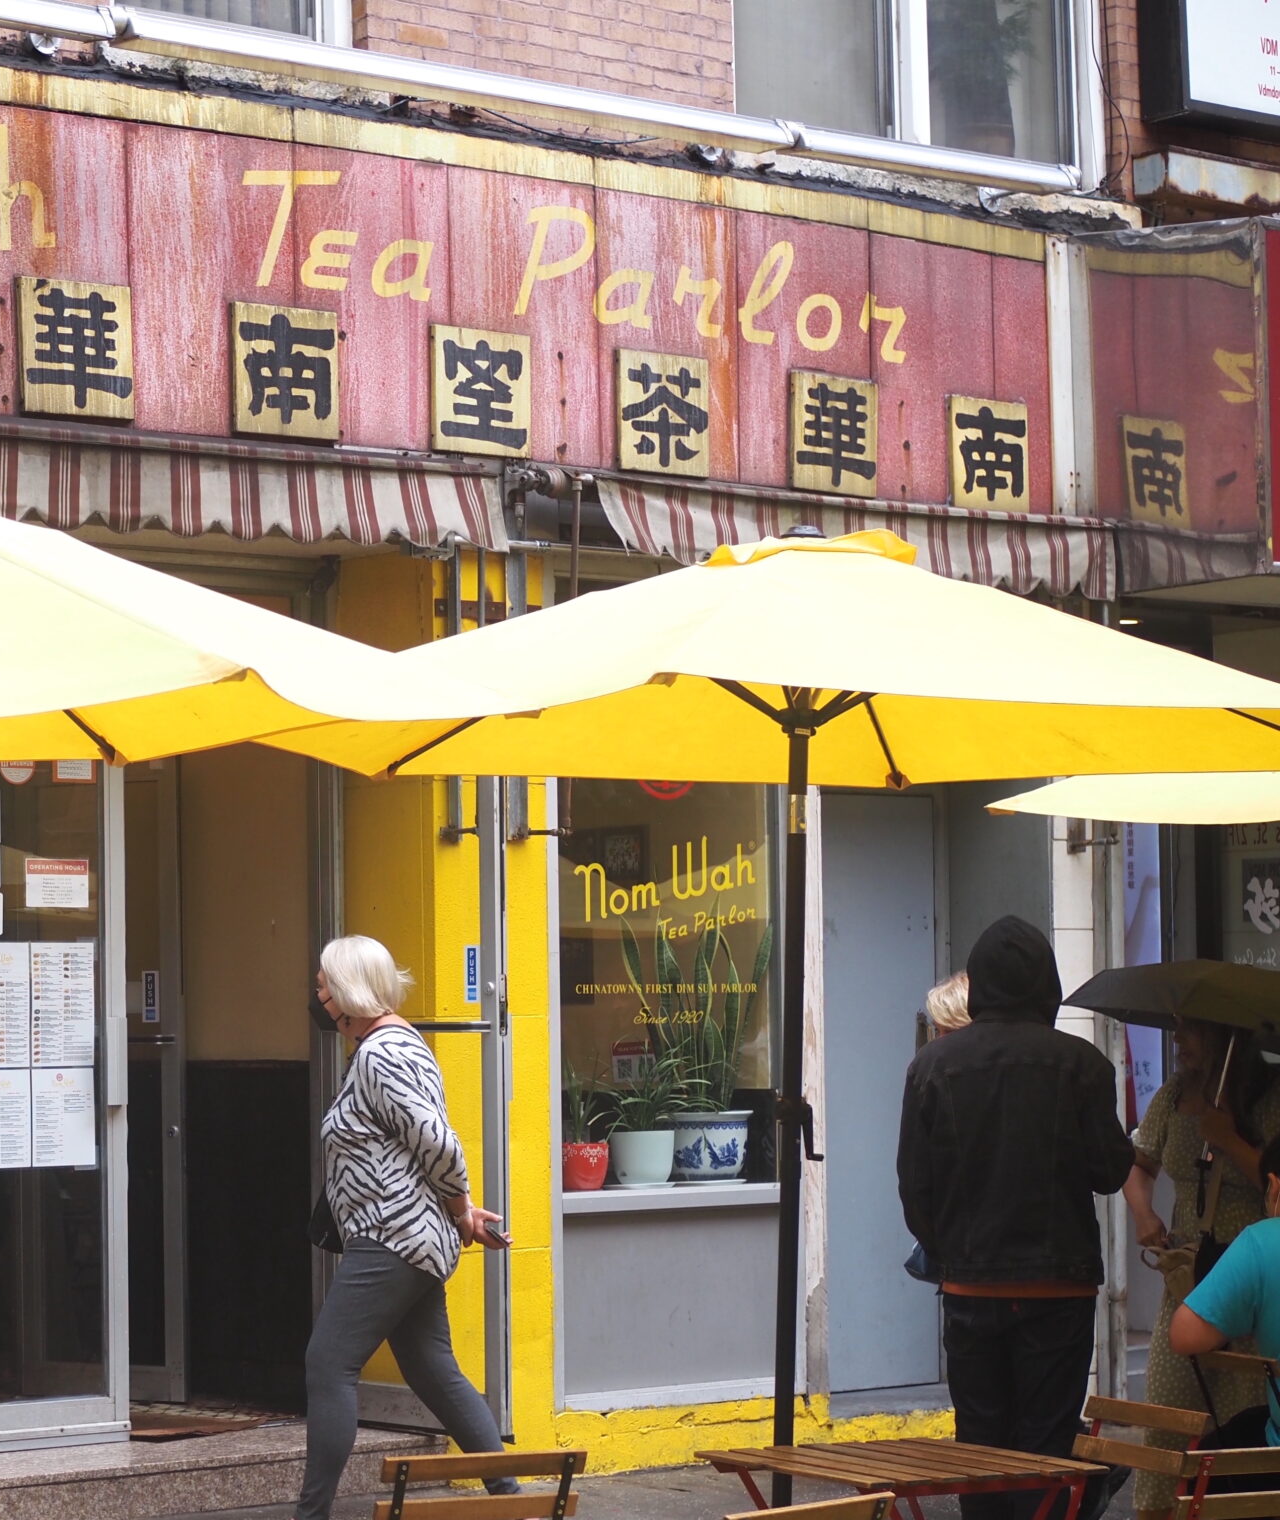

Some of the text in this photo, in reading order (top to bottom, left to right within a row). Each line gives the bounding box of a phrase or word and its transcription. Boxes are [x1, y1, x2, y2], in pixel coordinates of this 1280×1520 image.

[242, 170, 434, 303] Tea
[513, 205, 907, 364] Parlor
[26, 285, 133, 409] 華
[238, 314, 337, 423] 南
[621, 362, 709, 467] 茶
[796, 383, 877, 487] 華
[954, 406, 1027, 500] 南
[574, 835, 756, 922] Nom Wah
[658, 904, 757, 940] Tea Parlor
[633, 1007, 705, 1025] Since 1920
[645, 983, 673, 994] FIRST
[676, 983, 694, 993] DIM
[698, 983, 718, 993] SUM
[721, 983, 758, 993] PARLOR
